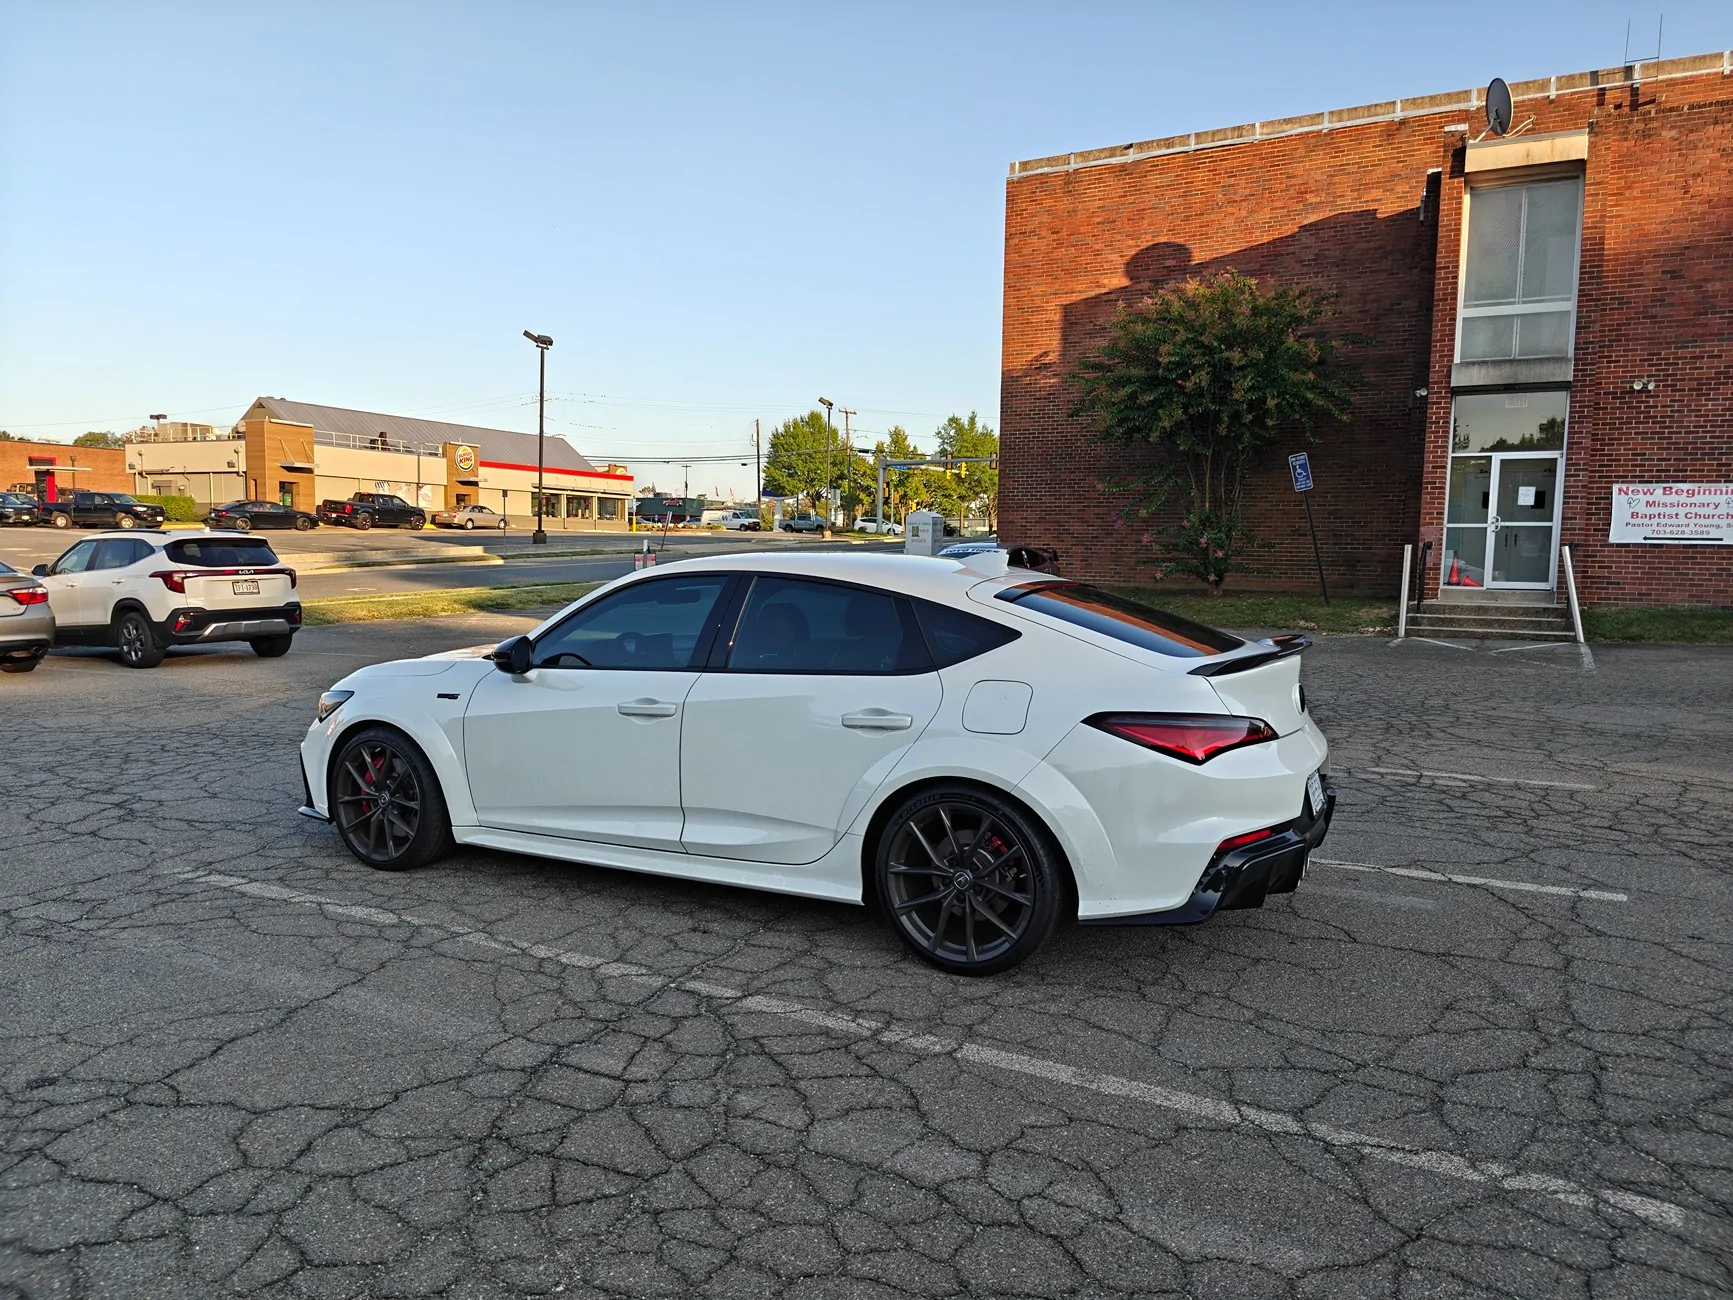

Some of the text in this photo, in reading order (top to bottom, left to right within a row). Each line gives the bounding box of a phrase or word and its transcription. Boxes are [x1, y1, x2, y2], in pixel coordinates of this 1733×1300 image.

[459, 456, 472, 464] KING
[1617, 486, 1656, 496] New
[1645, 500, 1721, 510] Missionary
[1630, 511, 1733, 521] Baptist Church
